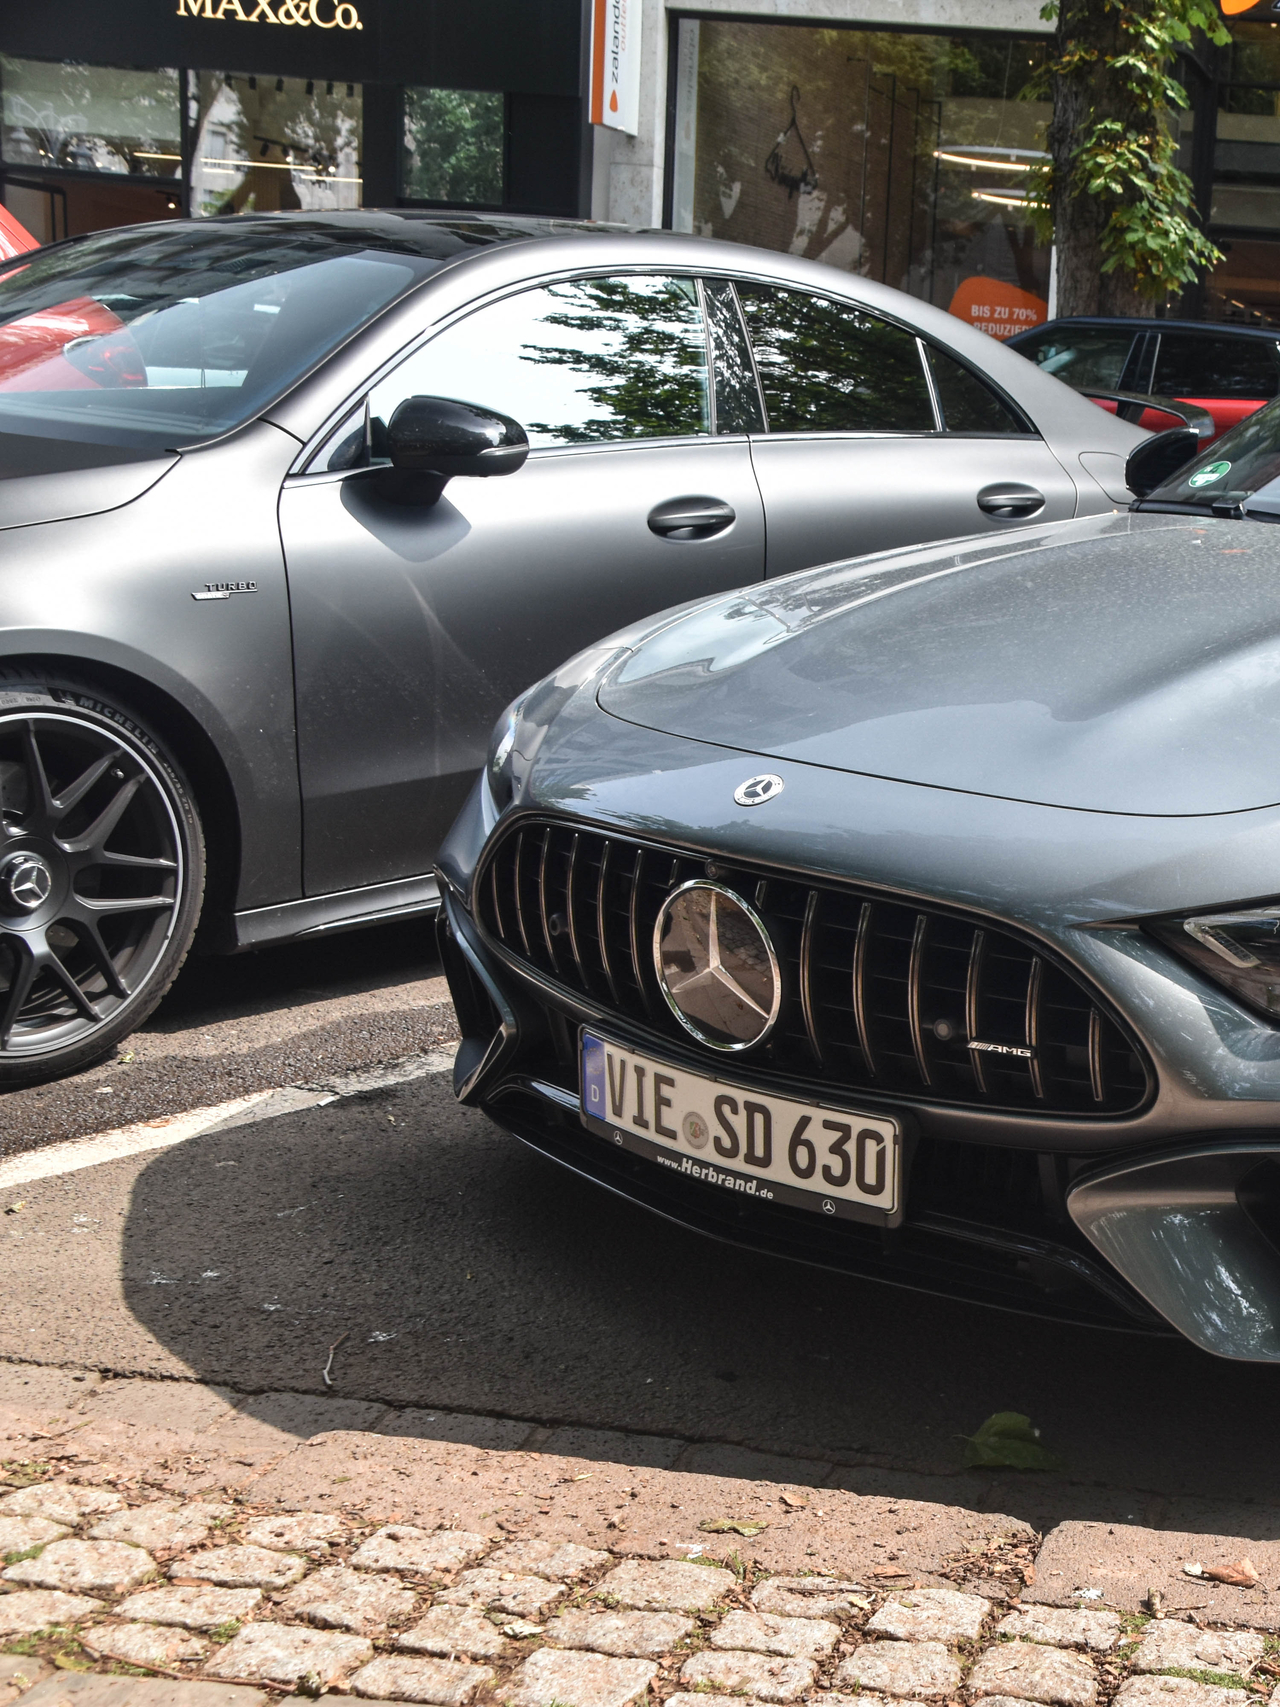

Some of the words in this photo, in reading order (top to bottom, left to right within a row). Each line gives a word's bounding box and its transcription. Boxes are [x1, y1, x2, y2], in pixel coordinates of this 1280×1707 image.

[620, 0, 628, 51] outle
[971, 304, 990, 318] BIS
[994, 306, 1009, 319] ZU
[1012, 308, 1037, 321] 70%
[205, 580, 257, 592] TURBO
[79, 697, 159, 754] MICHELIN
[987, 1044, 1032, 1057] AMG
[591, 1085, 599, 1102] D
[607, 1051, 678, 1141] VIE
[713, 1094, 773, 1169] SD
[788, 1115, 887, 1196] 630
[657, 1155, 774, 1200] www.Herbrand.de
